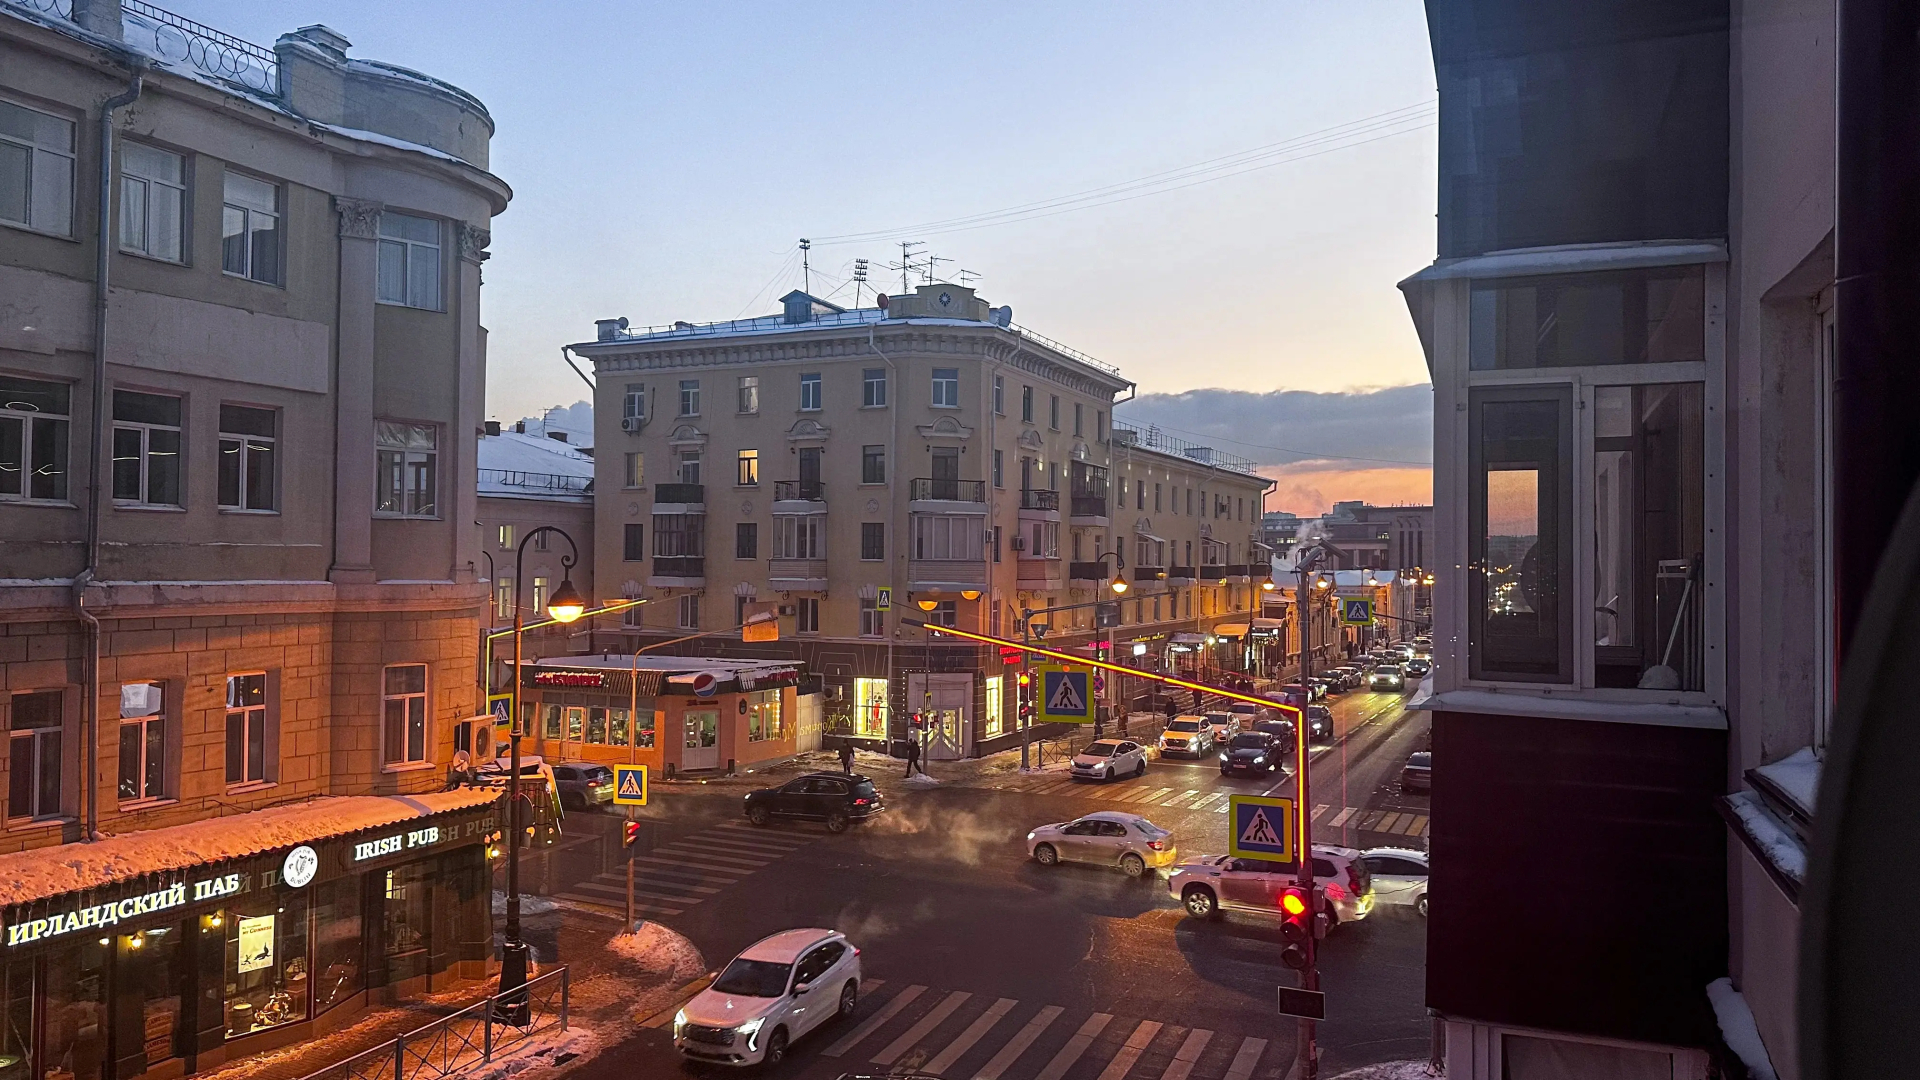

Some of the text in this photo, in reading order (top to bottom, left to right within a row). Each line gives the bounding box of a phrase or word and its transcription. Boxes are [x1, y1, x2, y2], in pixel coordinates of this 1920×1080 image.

[354, 835, 402, 861] IRISH
[407, 827, 439, 848] PUB
[8, 882, 186, 946] ИРЛАНДСКИЙ
[194, 873, 240, 901] ПАБ
